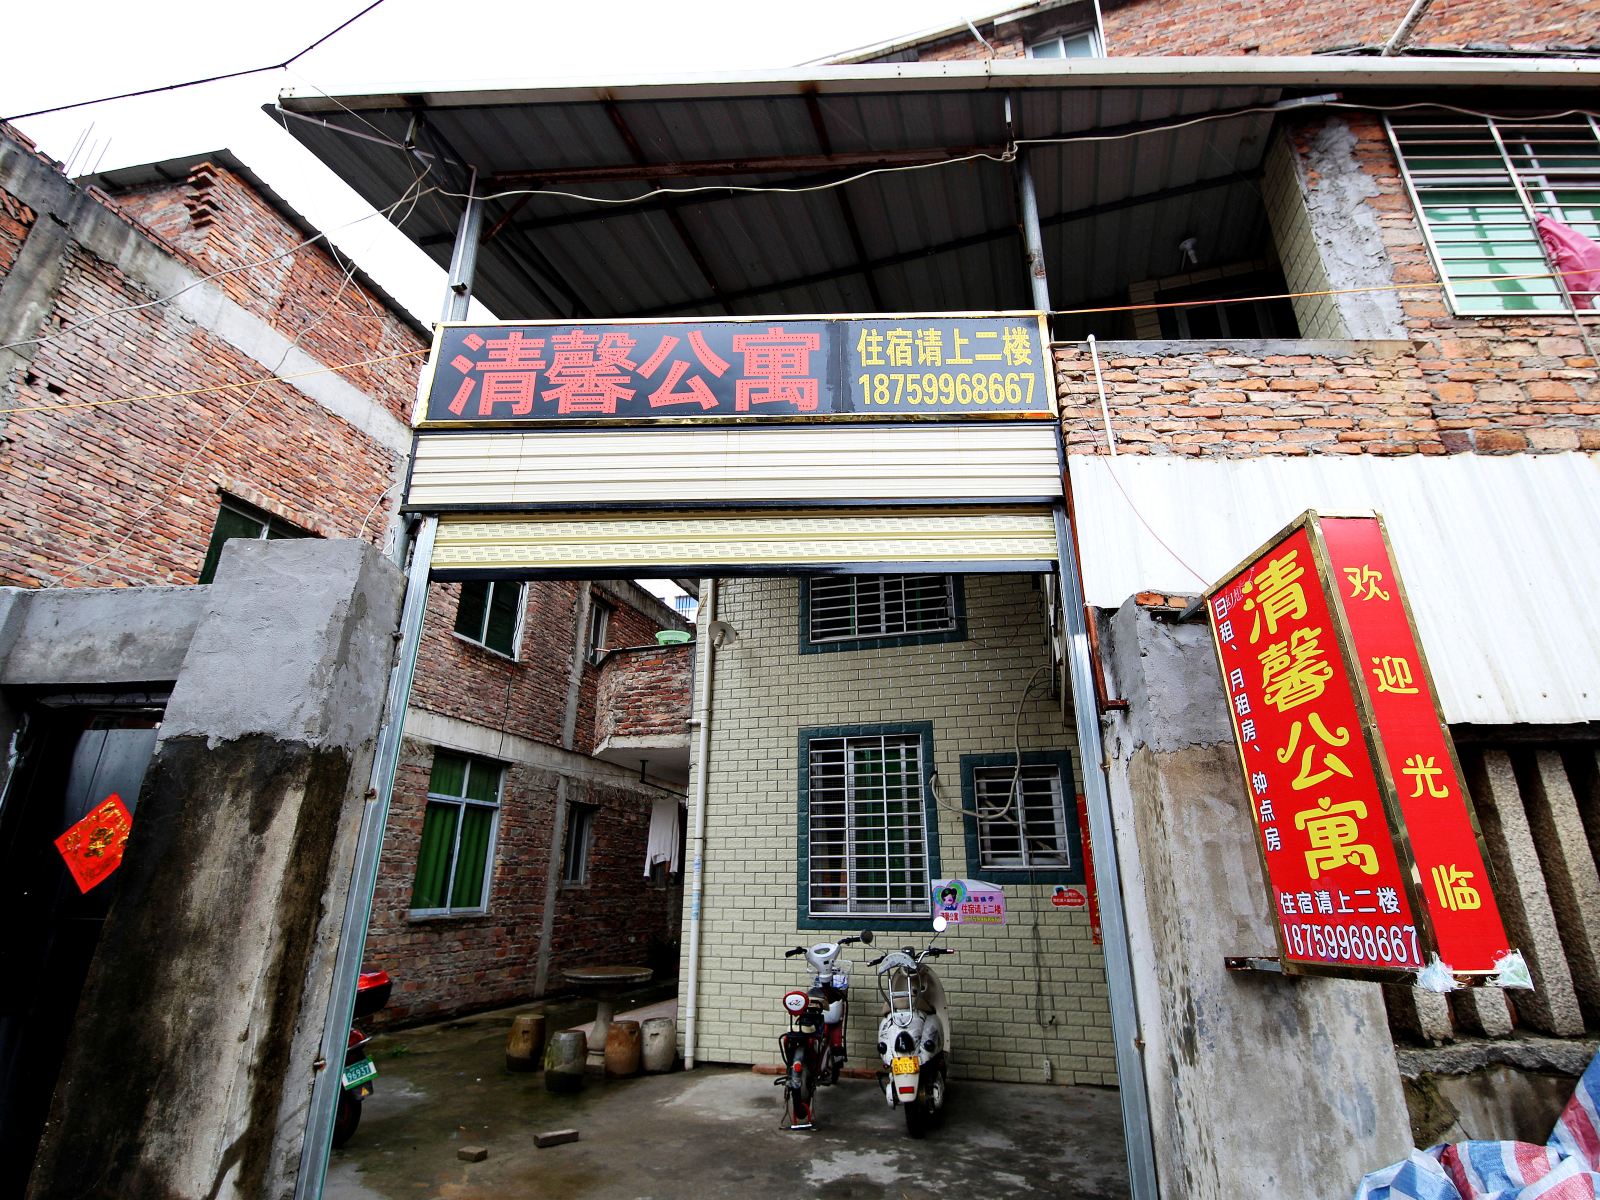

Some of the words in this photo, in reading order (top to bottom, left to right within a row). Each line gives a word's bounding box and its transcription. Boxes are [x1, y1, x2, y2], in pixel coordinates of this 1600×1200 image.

[857, 327, 1033, 368] 住宿请上二楼
[448, 327, 821, 416] 清馨公寓
[857, 372, 1035, 405] 18759968667
[1242, 549, 1379, 880] 清馨公寓
[1343, 564, 1481, 912] 欢迎光临
[1280, 887, 1400, 915] 住宿请上二楼
[1283, 922, 1419, 965] 18759968667
